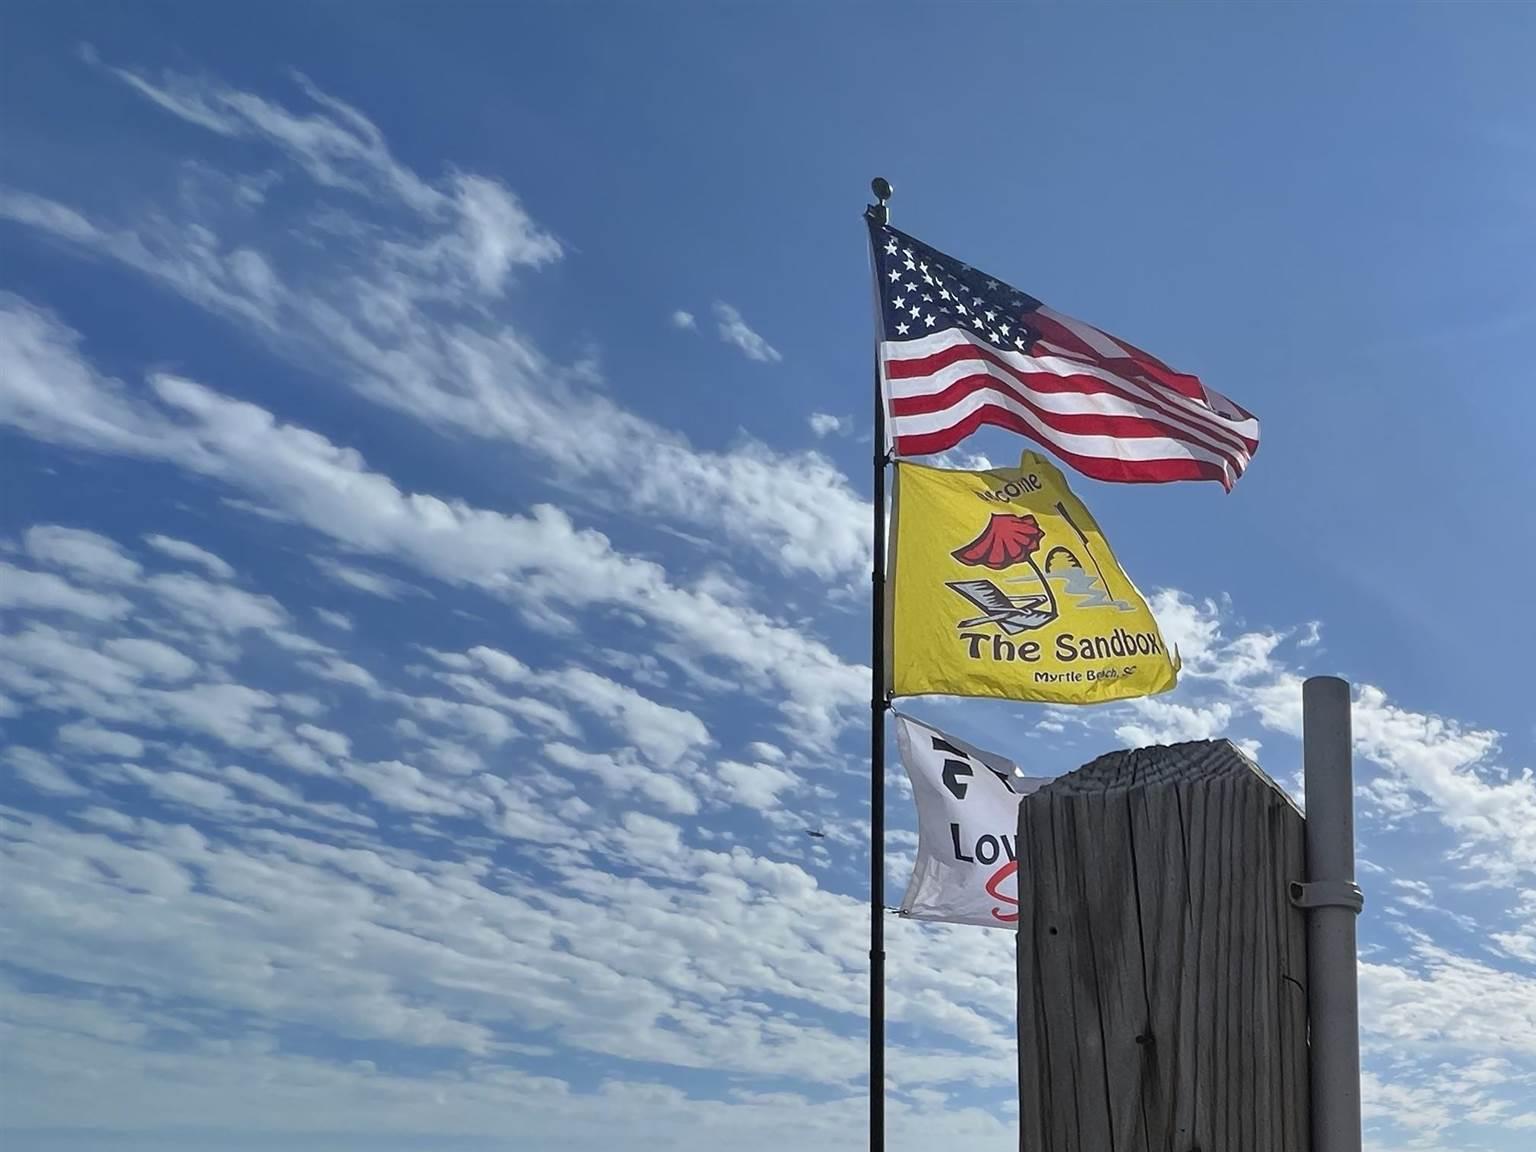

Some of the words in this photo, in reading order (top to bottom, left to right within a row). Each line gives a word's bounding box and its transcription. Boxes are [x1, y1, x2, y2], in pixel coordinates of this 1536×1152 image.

[959, 632, 1041, 662] The
[1055, 628, 1162, 662] Sandbox
[1034, 671, 1083, 682] Myrtle
